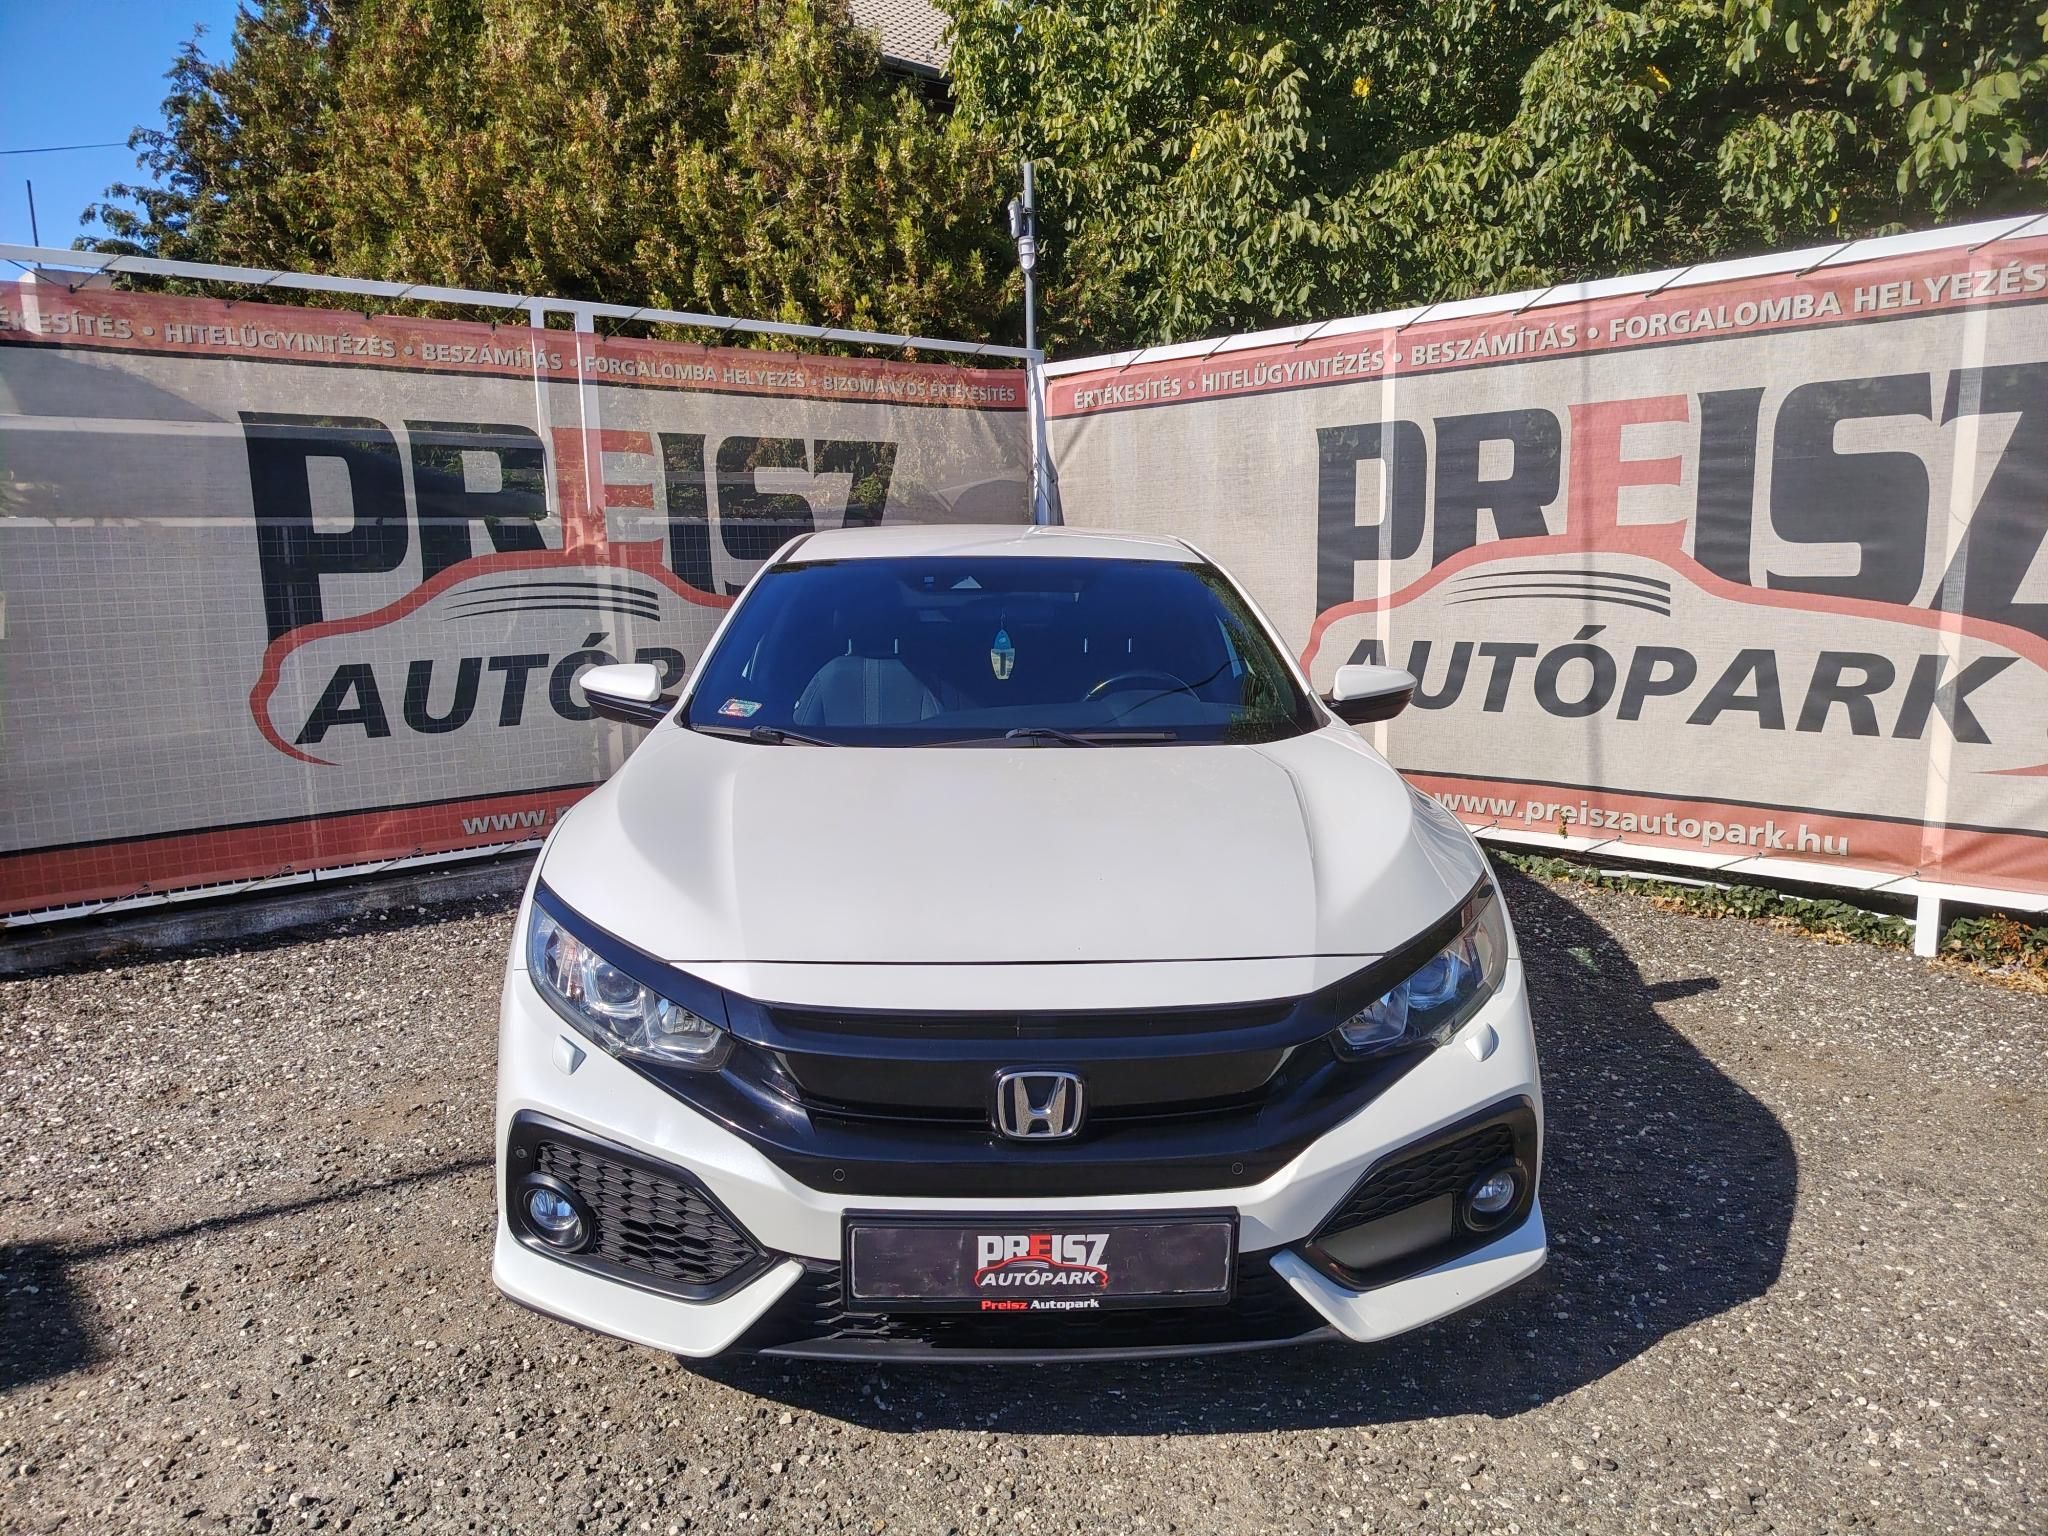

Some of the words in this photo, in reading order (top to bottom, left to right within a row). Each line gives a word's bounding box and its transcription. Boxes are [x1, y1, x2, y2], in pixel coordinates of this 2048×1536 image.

[165, 322, 396, 358] HITELÜGYINTÉZÉS
[422, 343, 562, 370] BESZÁMÍTÁS
[584, 355, 717, 382] FORGALOMBA
[723, 367, 805, 388] HELYEZÉS
[930, 379, 1016, 401] ÉRTÉKESÍTÉS
[1073, 377, 1181, 409] ÉRTÉKESÍTÉS
[1201, 348, 1384, 393] HITELÜGYINTÉZÉS
[1411, 319, 1577, 366] BESZÁMÍTÁS
[1609, 291, 1842, 342] FORGALOMBA
[1854, 260, 2048, 312] HELYEZÉS
[1316, 361, 2048, 637] PREISZ
[1434, 792, 1849, 857] www.preiszautopark.hu
[977, 1233, 1110, 1271] PREISZ
[980, 1269, 1098, 1287] AUTÓPARK
[981, 1299, 1029, 1311] Preisz
[1029, 1298, 1100, 1310] Autopark
